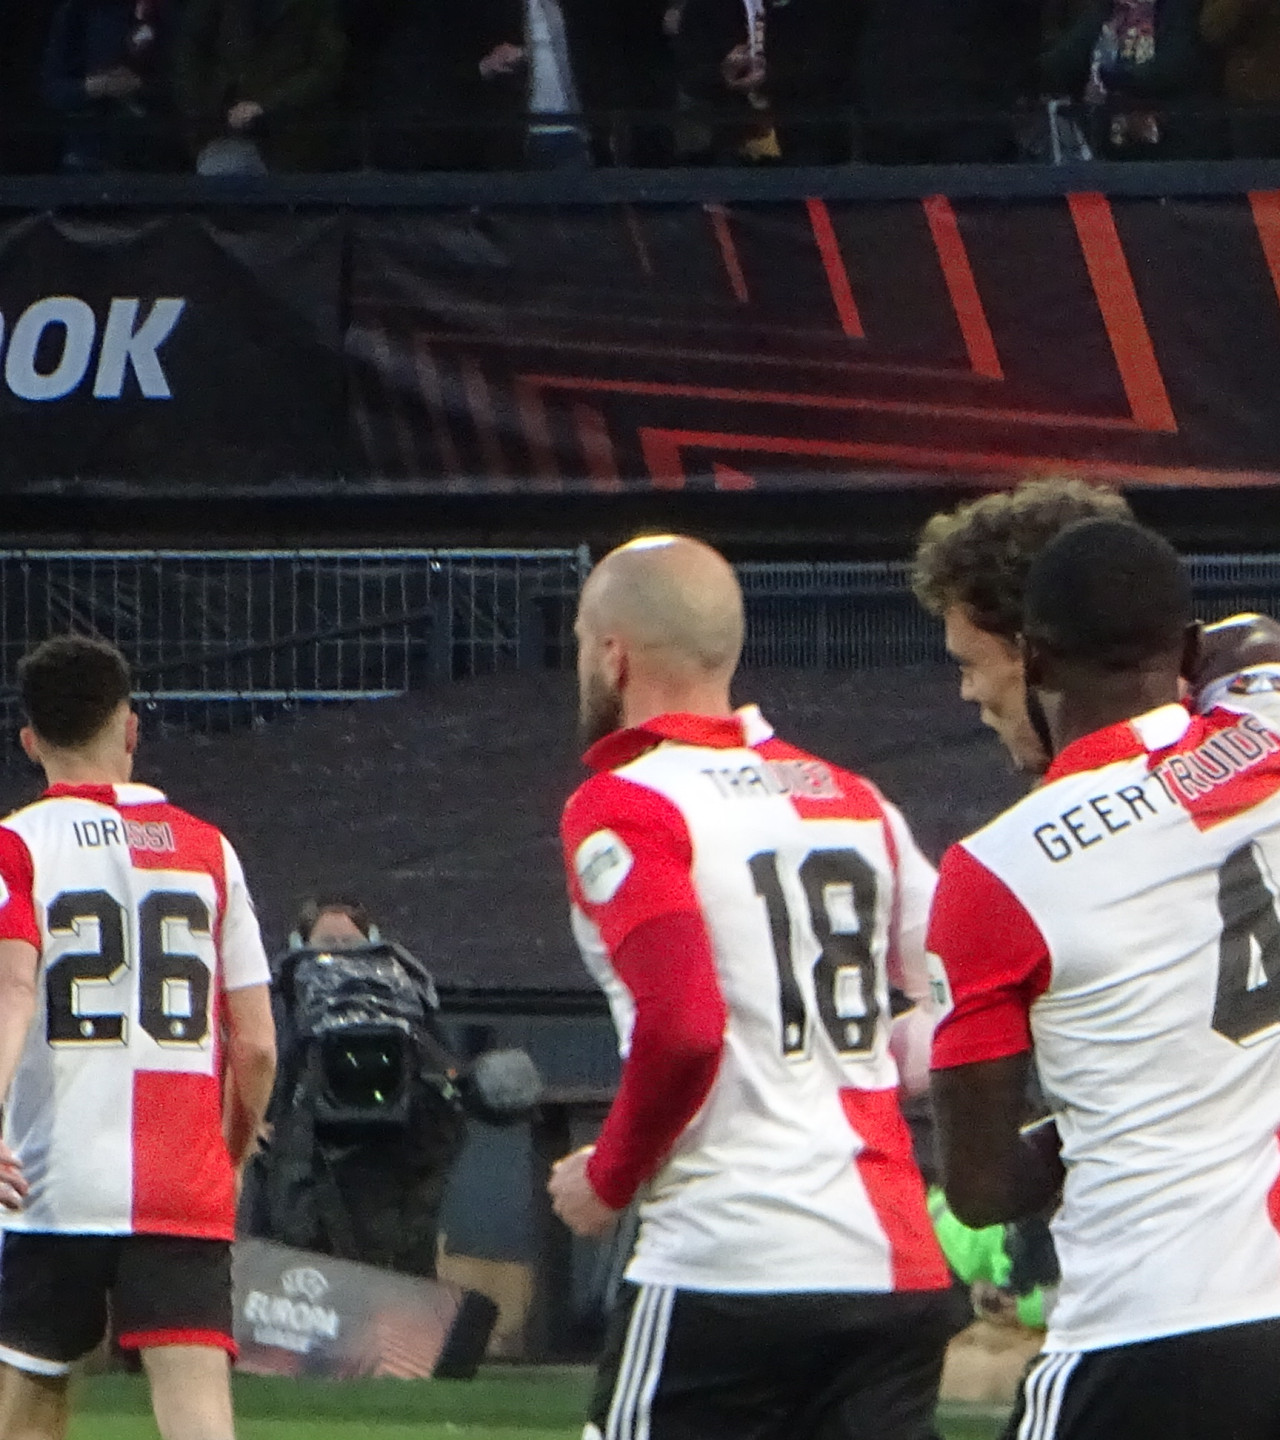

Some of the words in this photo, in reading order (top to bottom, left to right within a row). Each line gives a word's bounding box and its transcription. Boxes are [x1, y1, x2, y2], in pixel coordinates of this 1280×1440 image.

[0, 296, 185, 401] OK
[73, 818, 176, 852] IDRISSI
[46, 889, 219, 1050] 26
[746, 847, 886, 1064] 18
